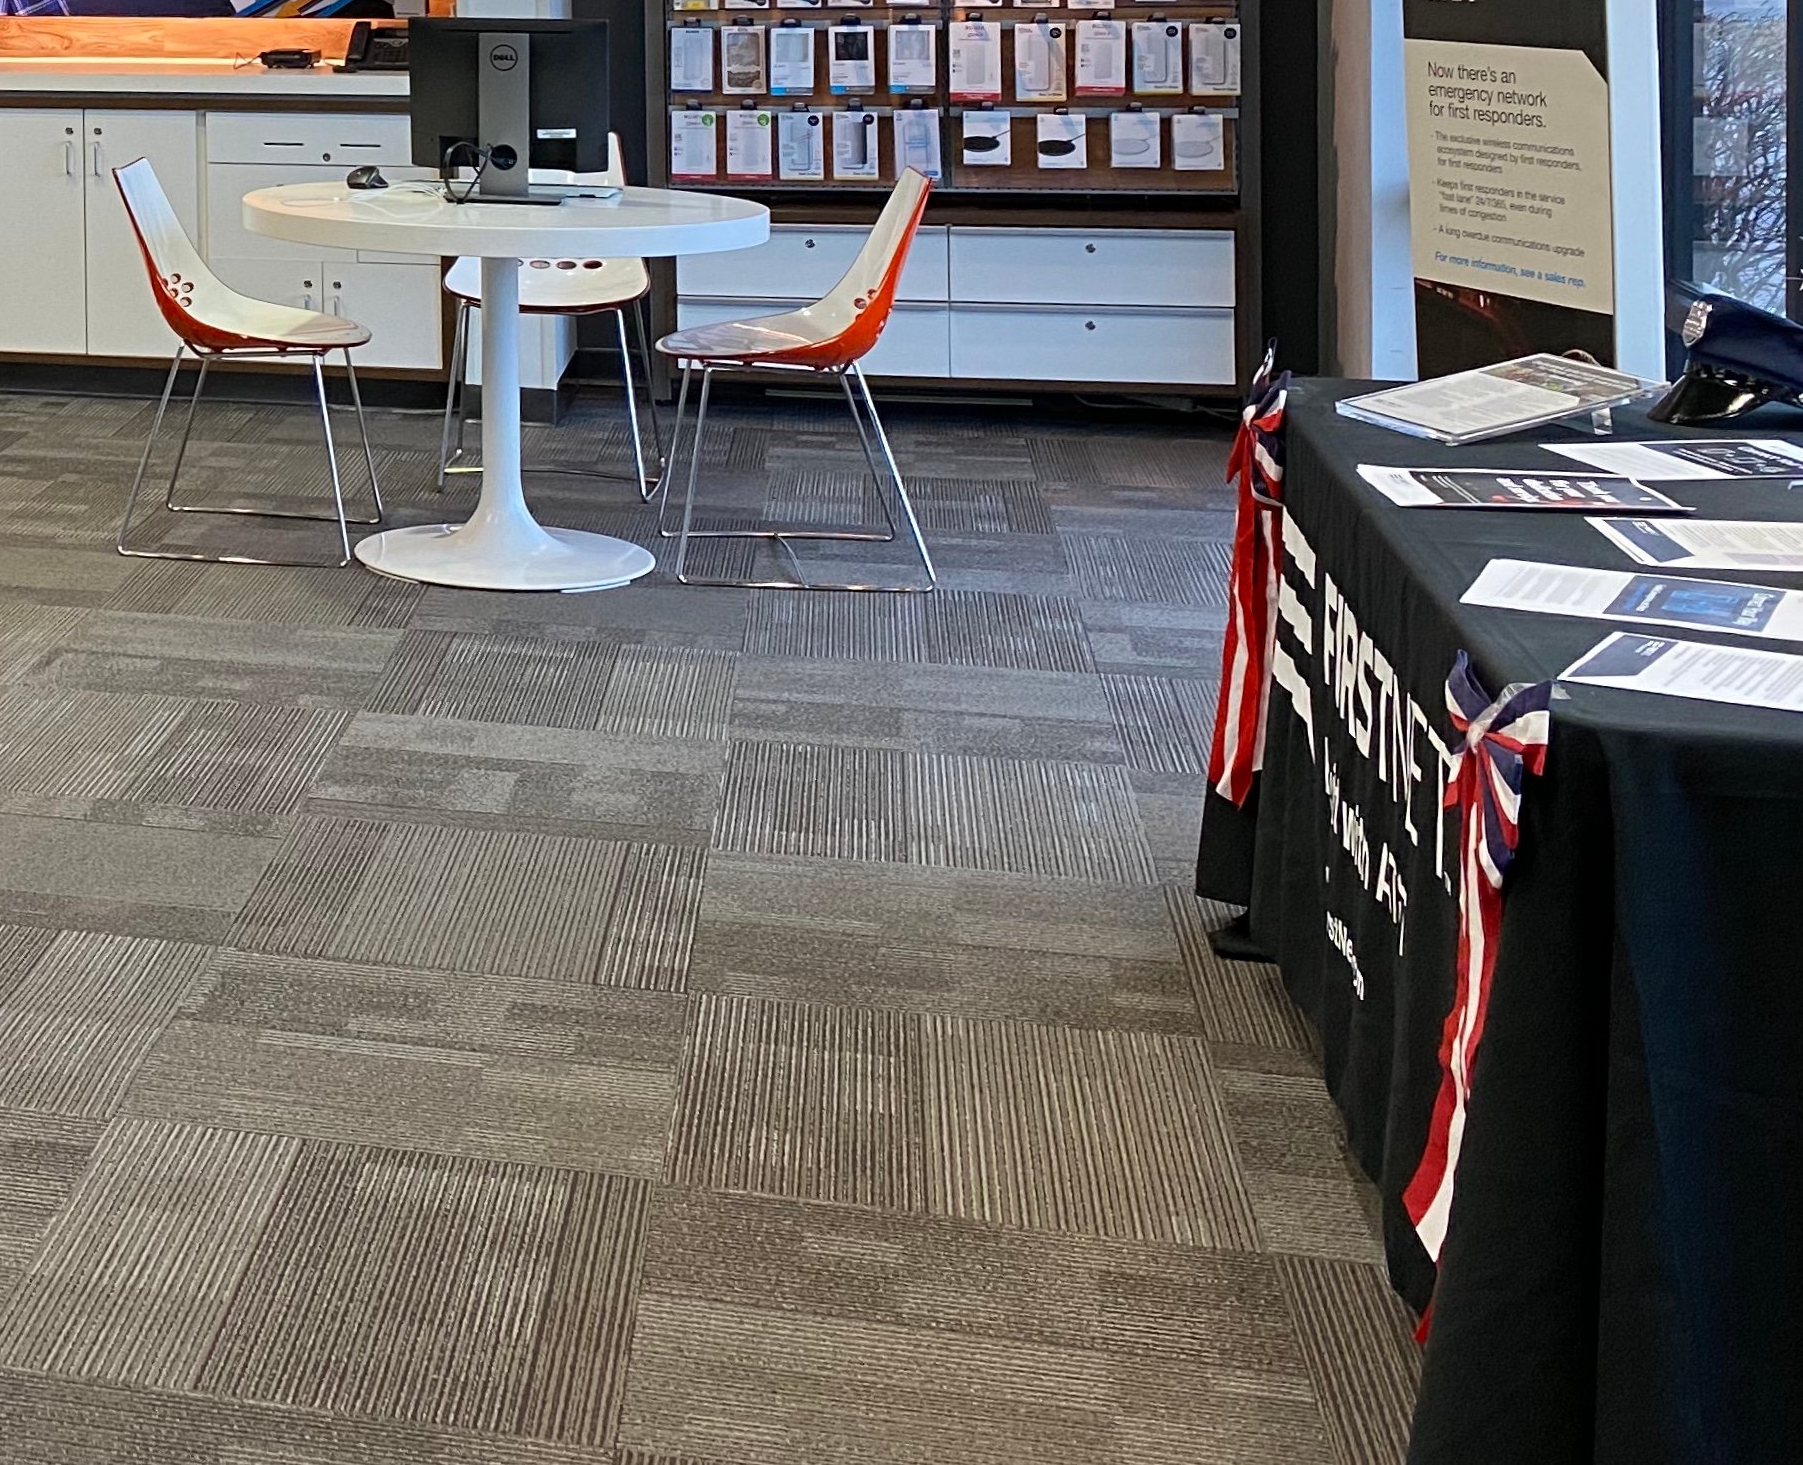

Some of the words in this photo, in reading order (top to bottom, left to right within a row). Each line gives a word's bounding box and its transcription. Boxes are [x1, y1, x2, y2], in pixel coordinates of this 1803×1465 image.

[1428, 61, 1454, 79] Now
[1457, 64, 1497, 83] there's
[1501, 71, 1516, 84] an
[1428, 84, 1493, 106] emergency
[1497, 90, 1547, 108] network
[1429, 100, 1445, 117] for
[1448, 103, 1470, 120] first
[1473, 109, 1547, 128] responders.
[1435, 131, 1448, 141] The
[1513, 140, 1575, 157] communications
[1438, 156, 1448, 166] for
[1448, 158, 1462, 168] first
[1475, 149, 1508, 162] designed
[1510, 152, 1519, 165] by
[1520, 154, 1534, 165] first
[1460, 180, 1473, 191] first
[1474, 184, 1515, 199] responders
[1516, 190, 1523, 199] in
[1525, 190, 1537, 201] the
[1538, 193, 1565, 205] service
[1459, 206, 1466, 216] of
[1509, 203, 1527, 212] even
[1529, 205, 1552, 219] during
[1491, 235, 1551, 252] communications
[1552, 244, 1585, 257] upgrade
[1435, 251, 1447, 262] For
[1449, 255, 1469, 266] more
[1470, 258, 1519, 277] information,
[1520, 268, 1535, 279] see
[1544, 272, 1566, 284] sales
